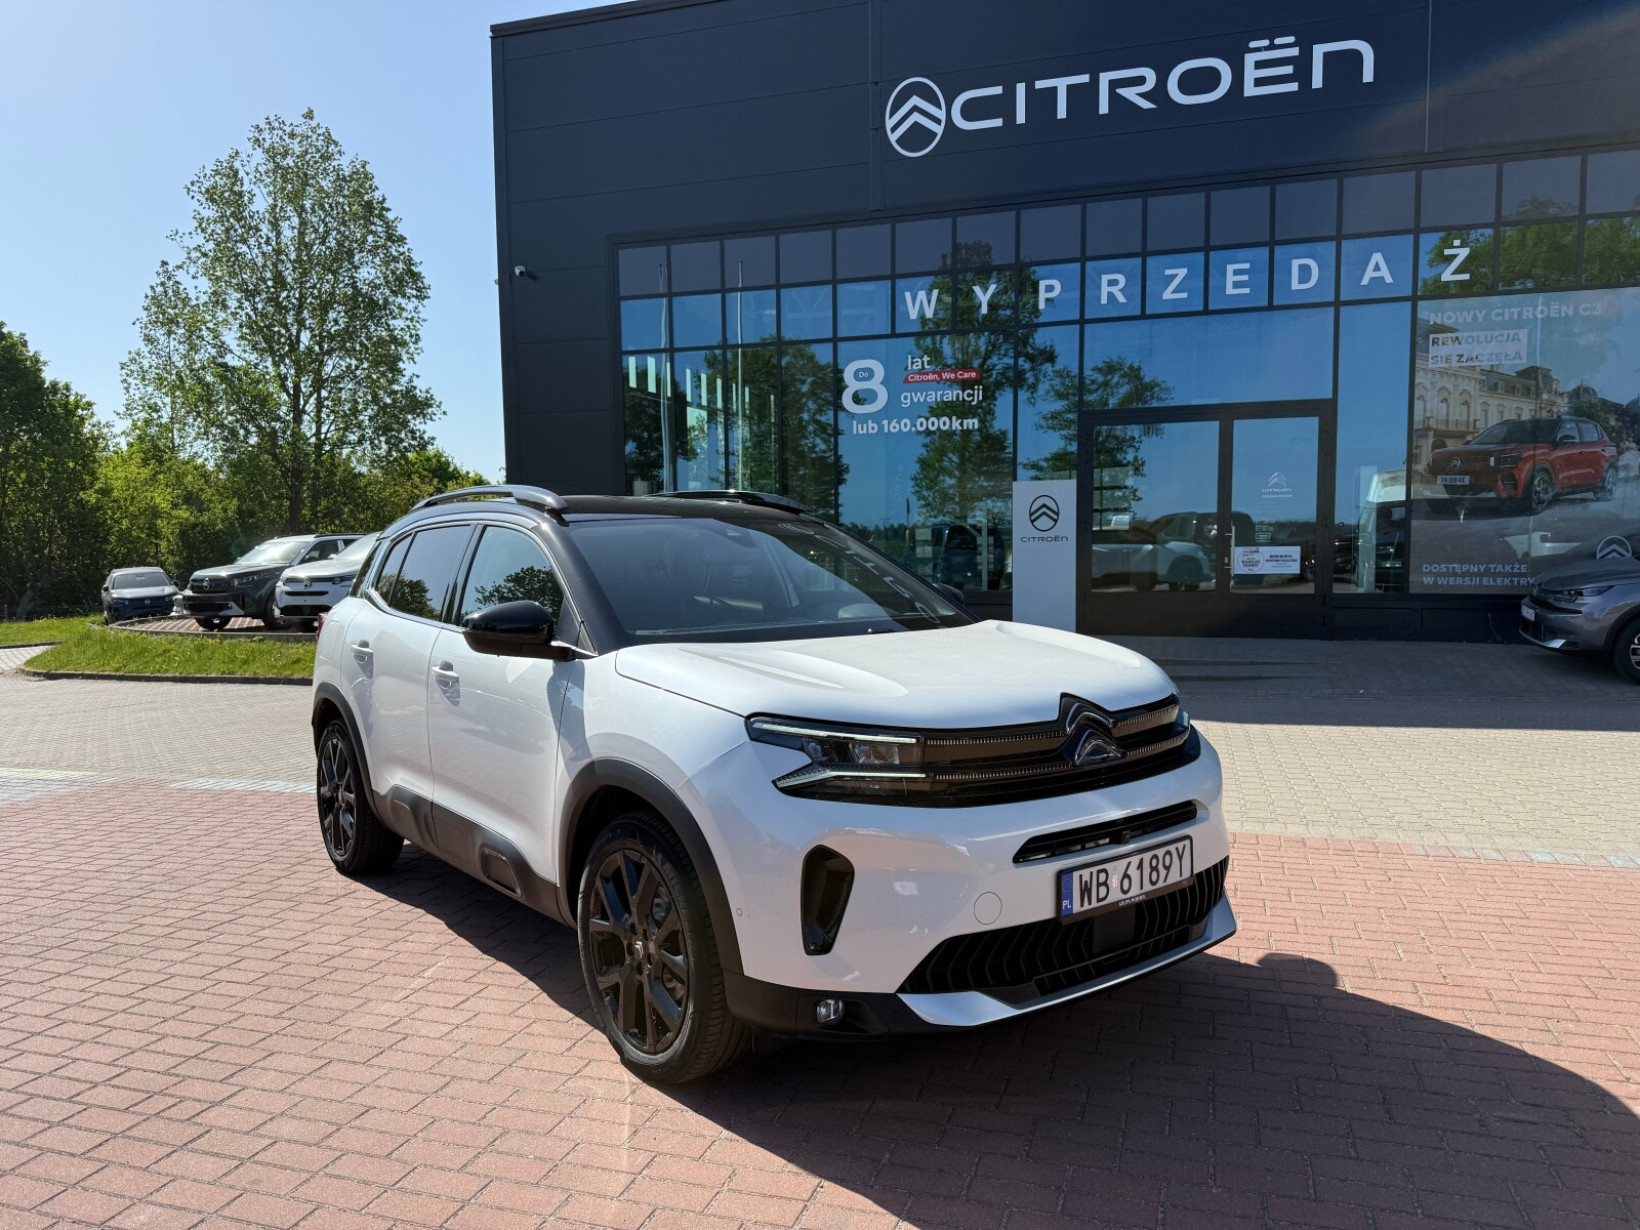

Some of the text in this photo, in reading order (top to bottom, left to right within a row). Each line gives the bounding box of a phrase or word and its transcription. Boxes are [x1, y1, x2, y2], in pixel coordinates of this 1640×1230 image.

[950, 35, 1375, 131] CITROËN
[1430, 302, 1603, 325] NOWY CITROËN C3
[1431, 332, 1521, 347] REWOLUCJA
[907, 354, 931, 371] lat
[941, 371, 956, 380] We
[956, 370, 977, 379] Care
[841, 358, 889, 415] 8
[900, 385, 983, 408] gwarancji
[852, 420, 878, 435] lub
[1020, 534, 1069, 543] CITROËN
[1422, 562, 1528, 574] DOSTĘPNY TAKŻE
[1422, 576, 1434, 585] W
[1436, 576, 1480, 586] WERSJI
[1078, 843, 1187, 908] WB 6189Y
[1062, 900, 1072, 910] PL
